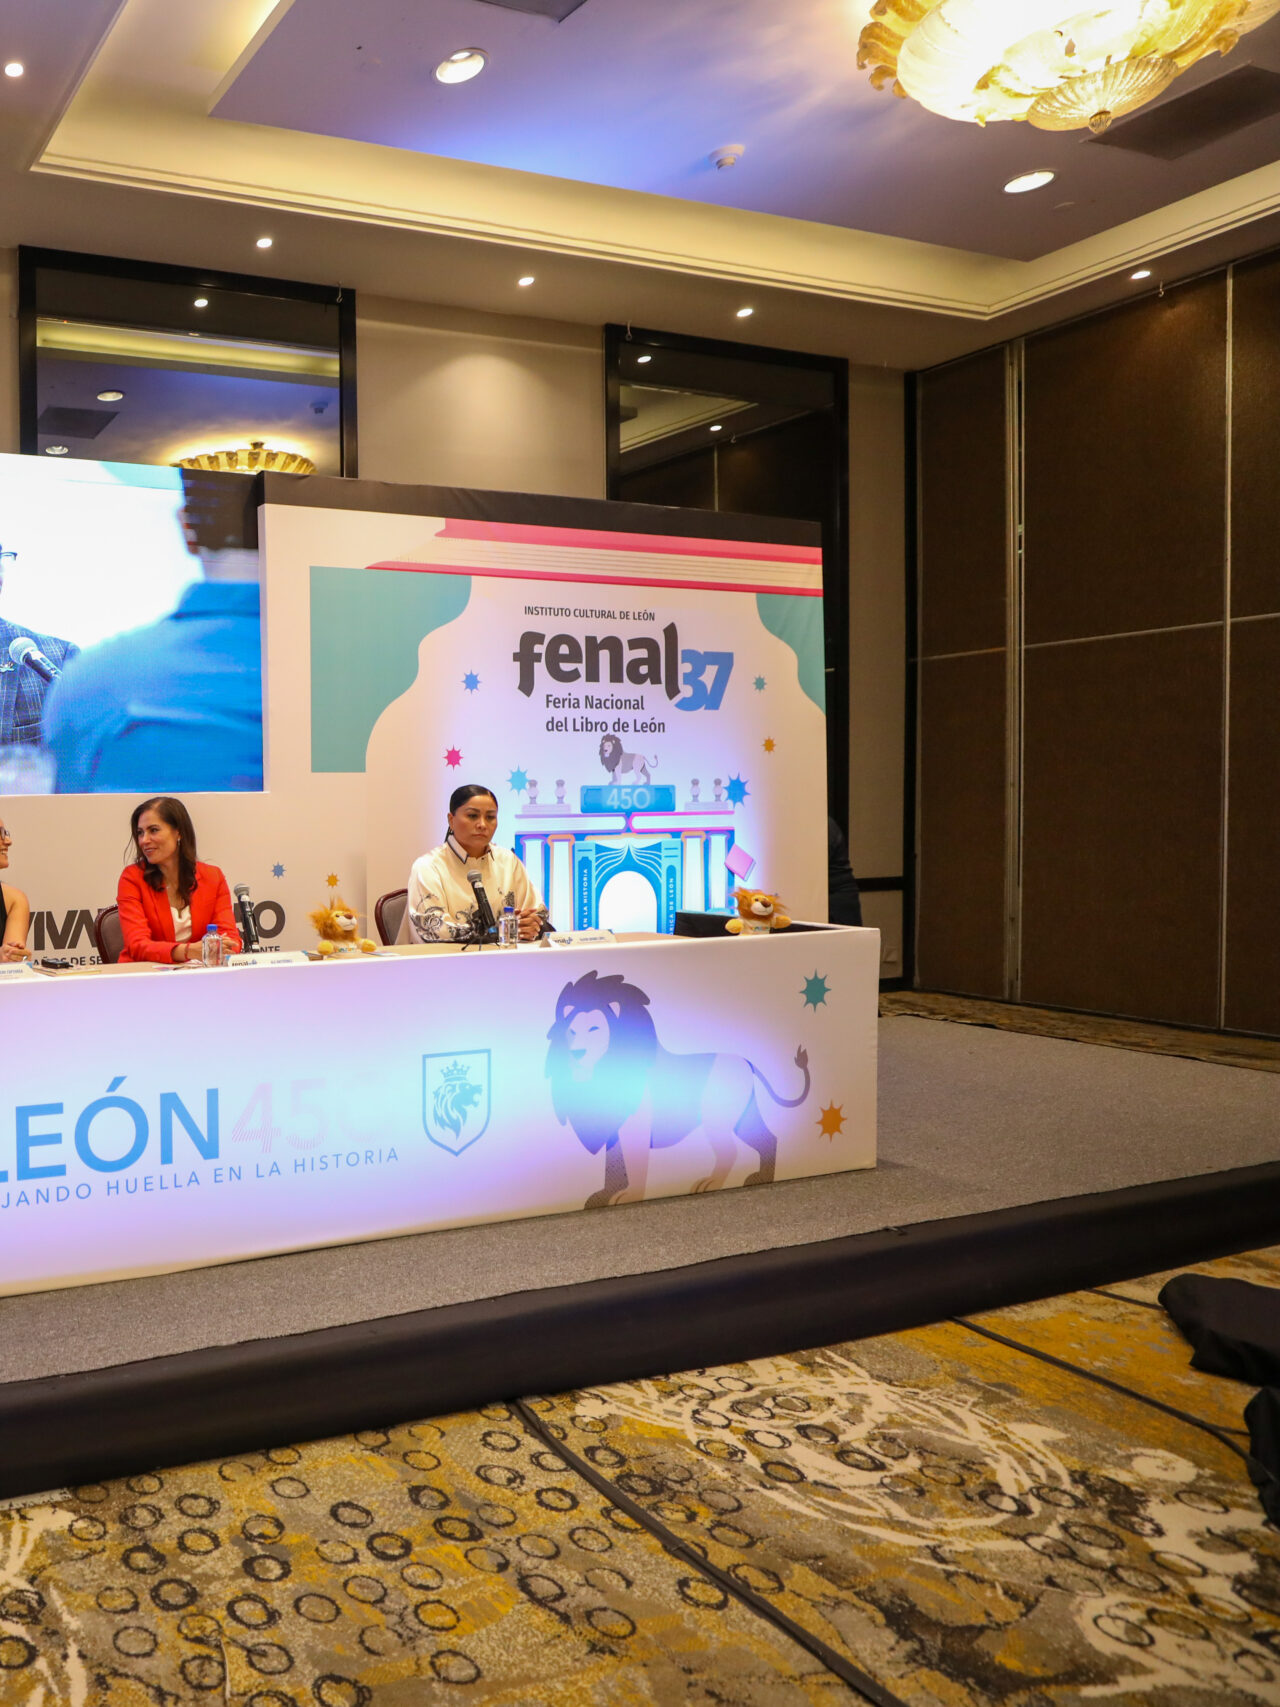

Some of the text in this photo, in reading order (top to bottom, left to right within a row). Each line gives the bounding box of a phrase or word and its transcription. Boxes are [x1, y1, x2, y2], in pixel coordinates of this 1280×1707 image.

[524, 606, 655, 621] INSTITUTO CULTURAL DE LEÓN
[513, 622, 734, 712] fenal 37
[546, 692, 644, 710] Feria Nacional
[546, 716, 665, 733] del Libro de León
[606, 788, 652, 810] 450
[107, 1171, 200, 1196] HUELLA
[214, 1165, 242, 1184] EN
[256, 1161, 281, 1178] LA
[294, 1147, 399, 1174] HISTORIA
